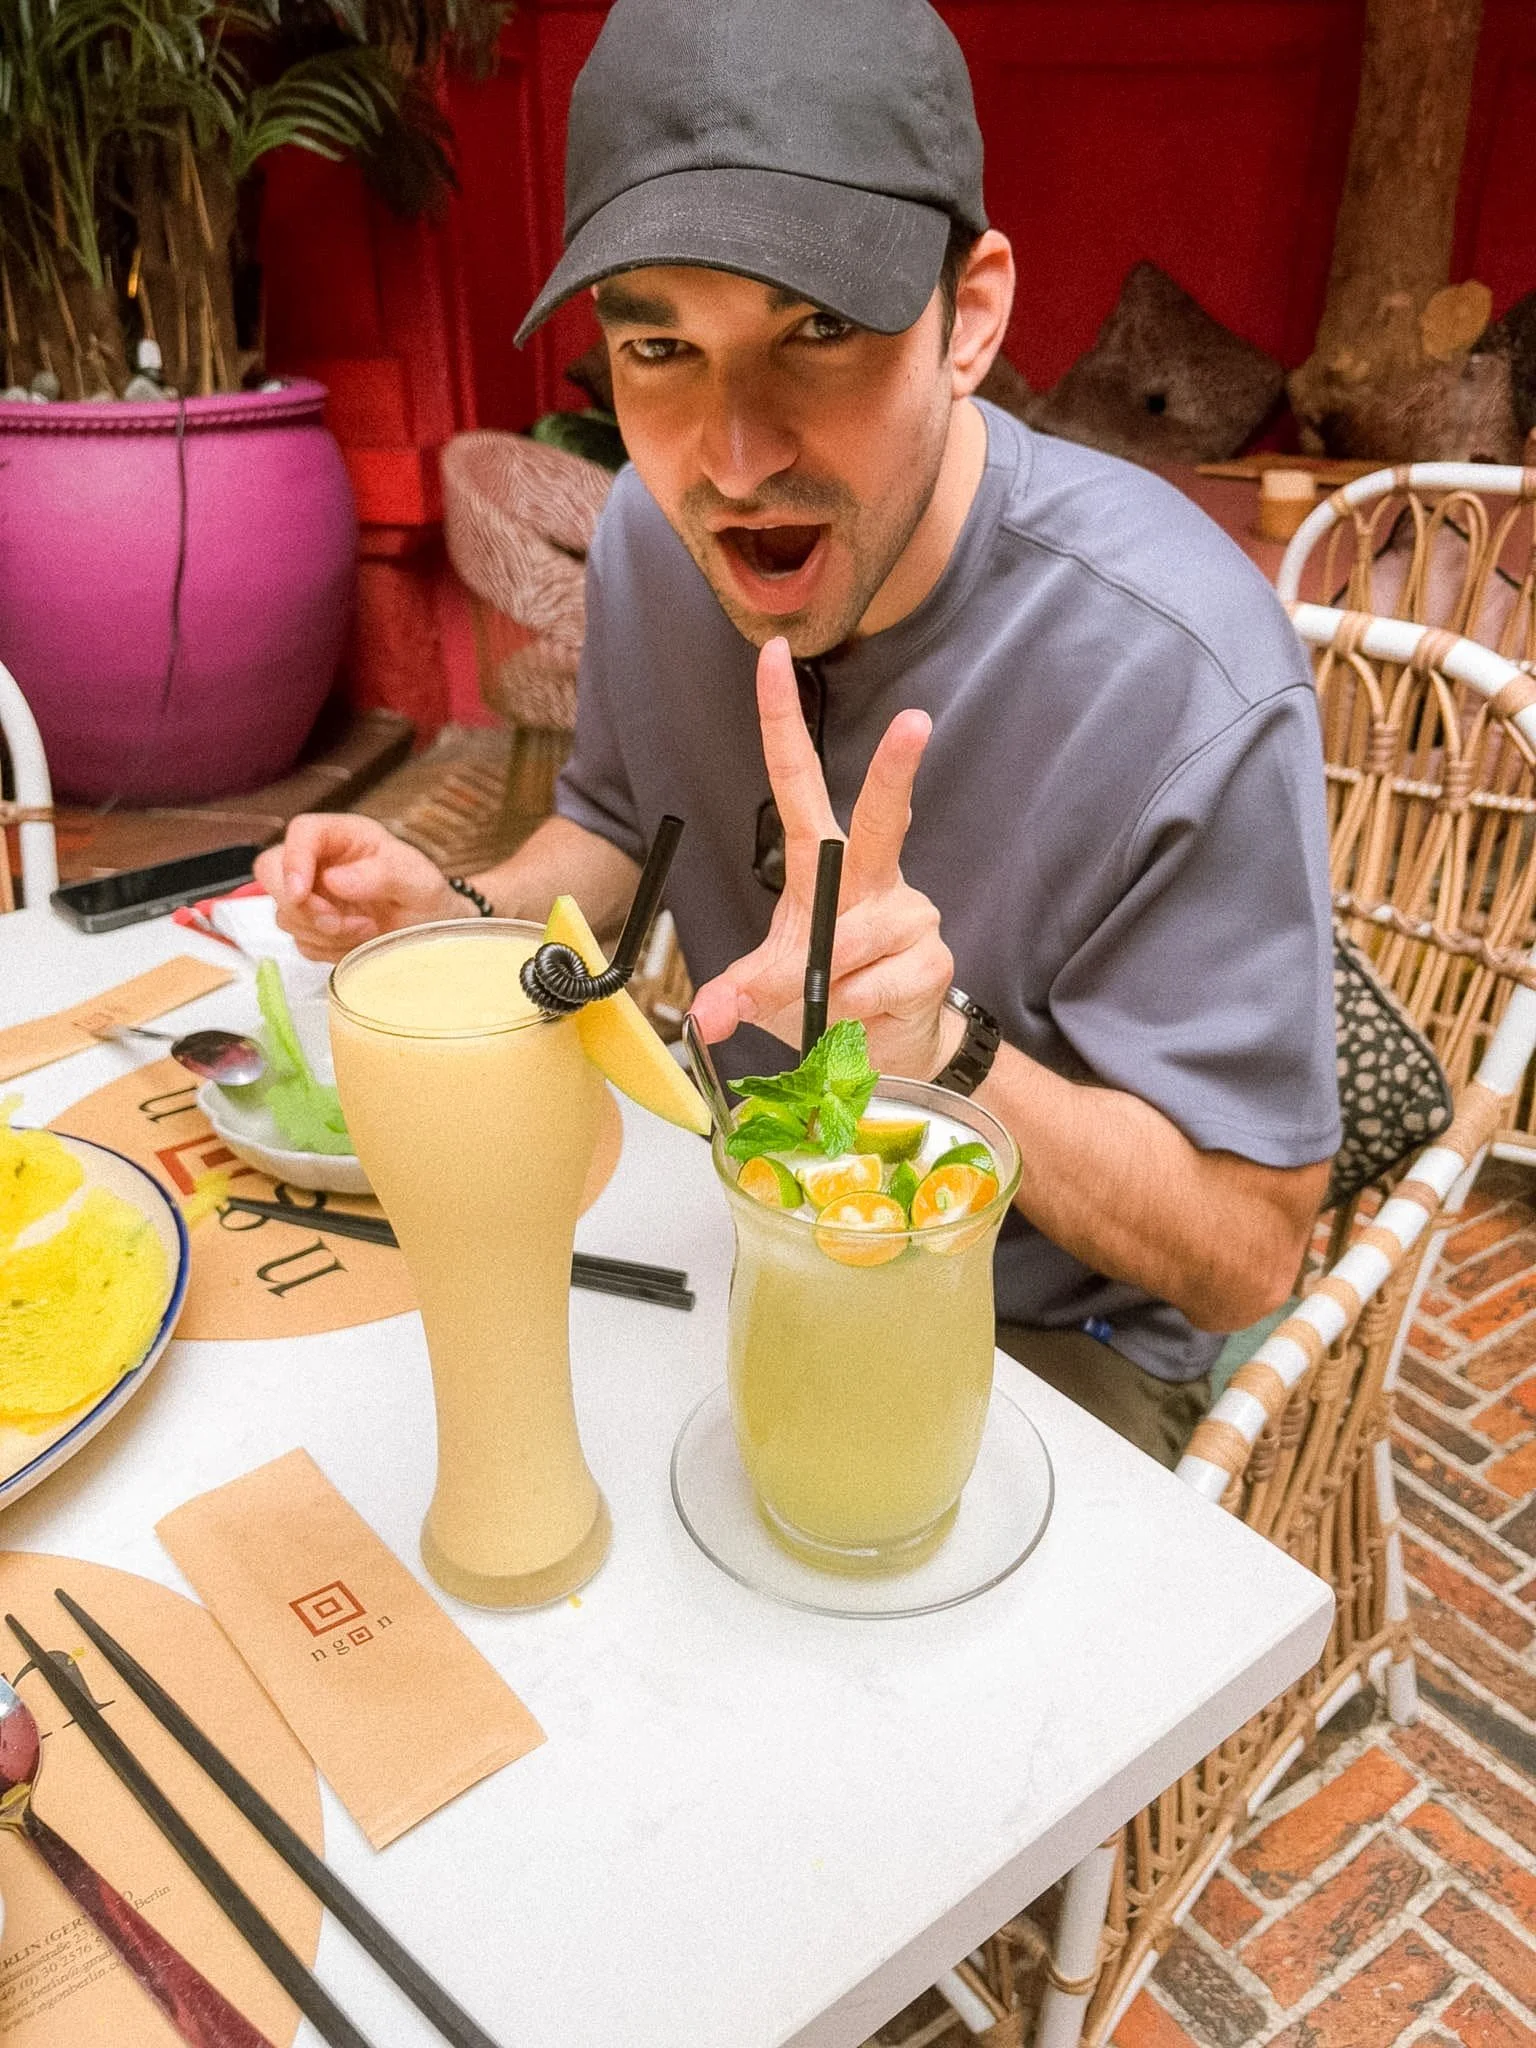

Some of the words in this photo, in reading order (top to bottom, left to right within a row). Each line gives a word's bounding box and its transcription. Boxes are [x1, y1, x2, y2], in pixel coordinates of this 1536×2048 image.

[134, 1886, 171, 1910] Berlin
[2, 1943, 41, 1968] RLIN
[41, 1962, 58, 1978] 30
[62, 1942, 93, 1968] 2576
